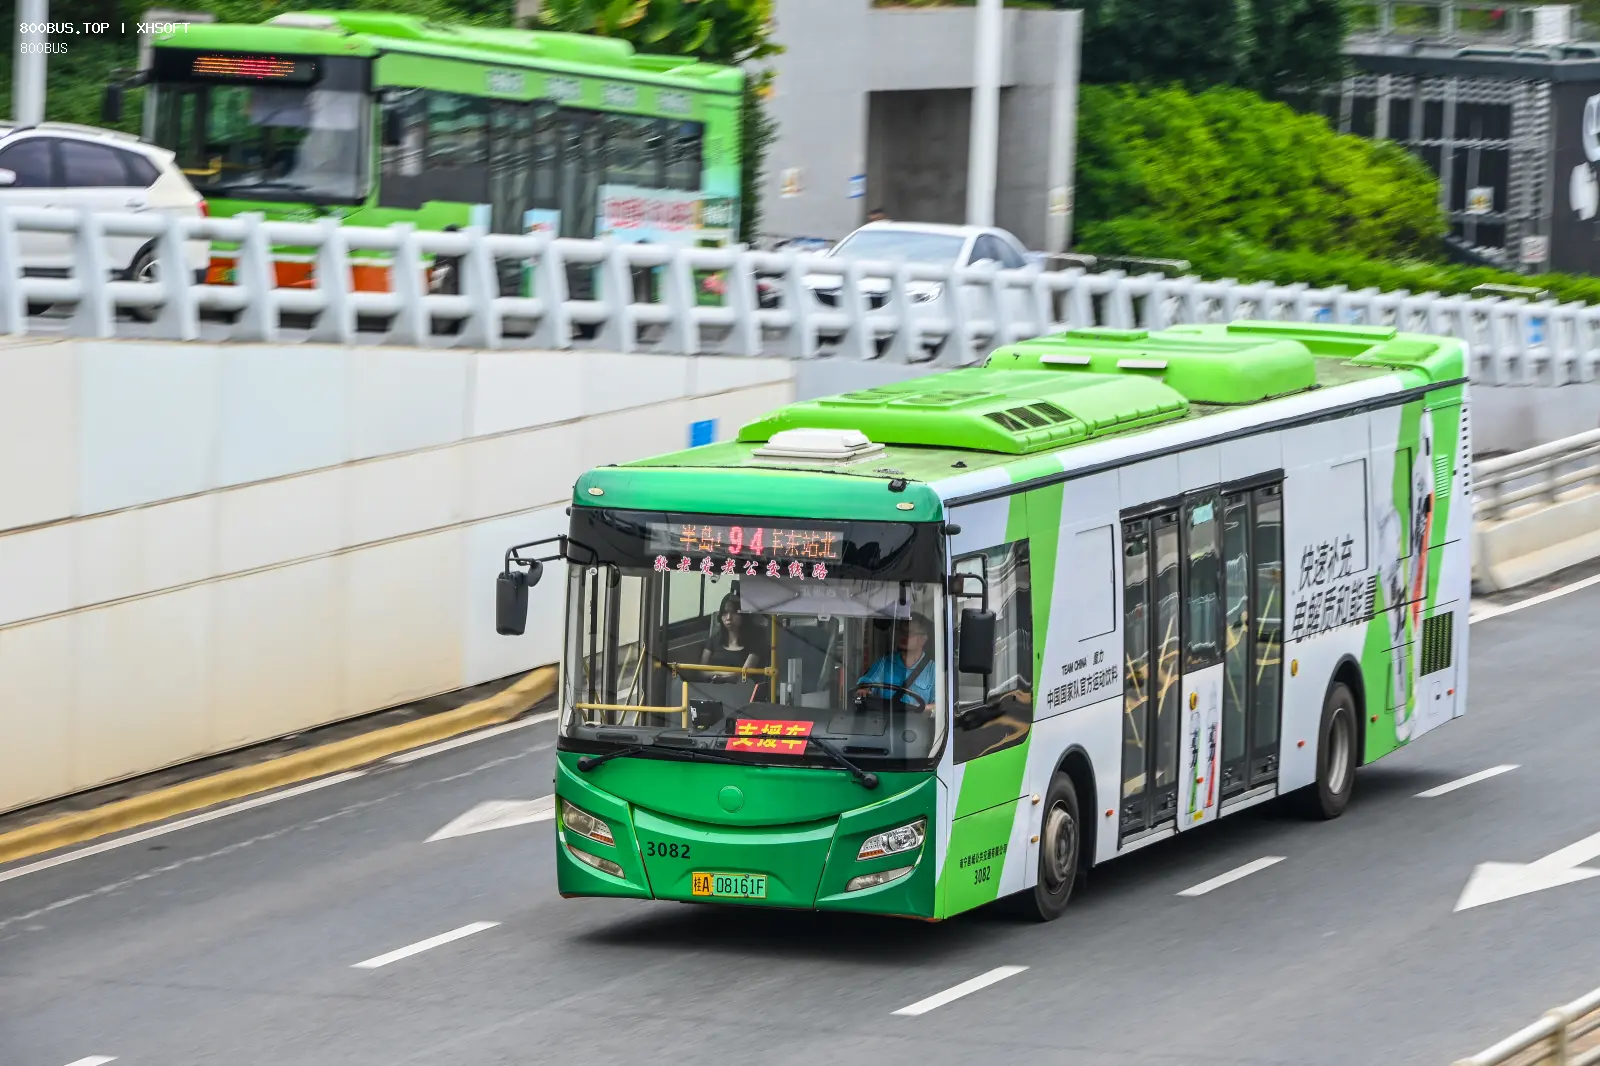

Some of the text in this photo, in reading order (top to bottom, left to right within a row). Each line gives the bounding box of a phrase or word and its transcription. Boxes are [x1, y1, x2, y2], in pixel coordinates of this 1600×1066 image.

[728, 526, 764, 556] 94
[654, 555, 828, 581] 敬老爱老公交线路
[1298, 533, 1354, 592] 快速补充
[1291, 574, 1377, 643] 电解质和能量
[1061, 662, 1074, 676] TEAM
[1047, 664, 1118, 709] 中国国家队官方运动饮料
[733, 723, 806, 749] 支援车
[647, 841, 691, 859] 3082
[974, 866, 991, 885] 3082
